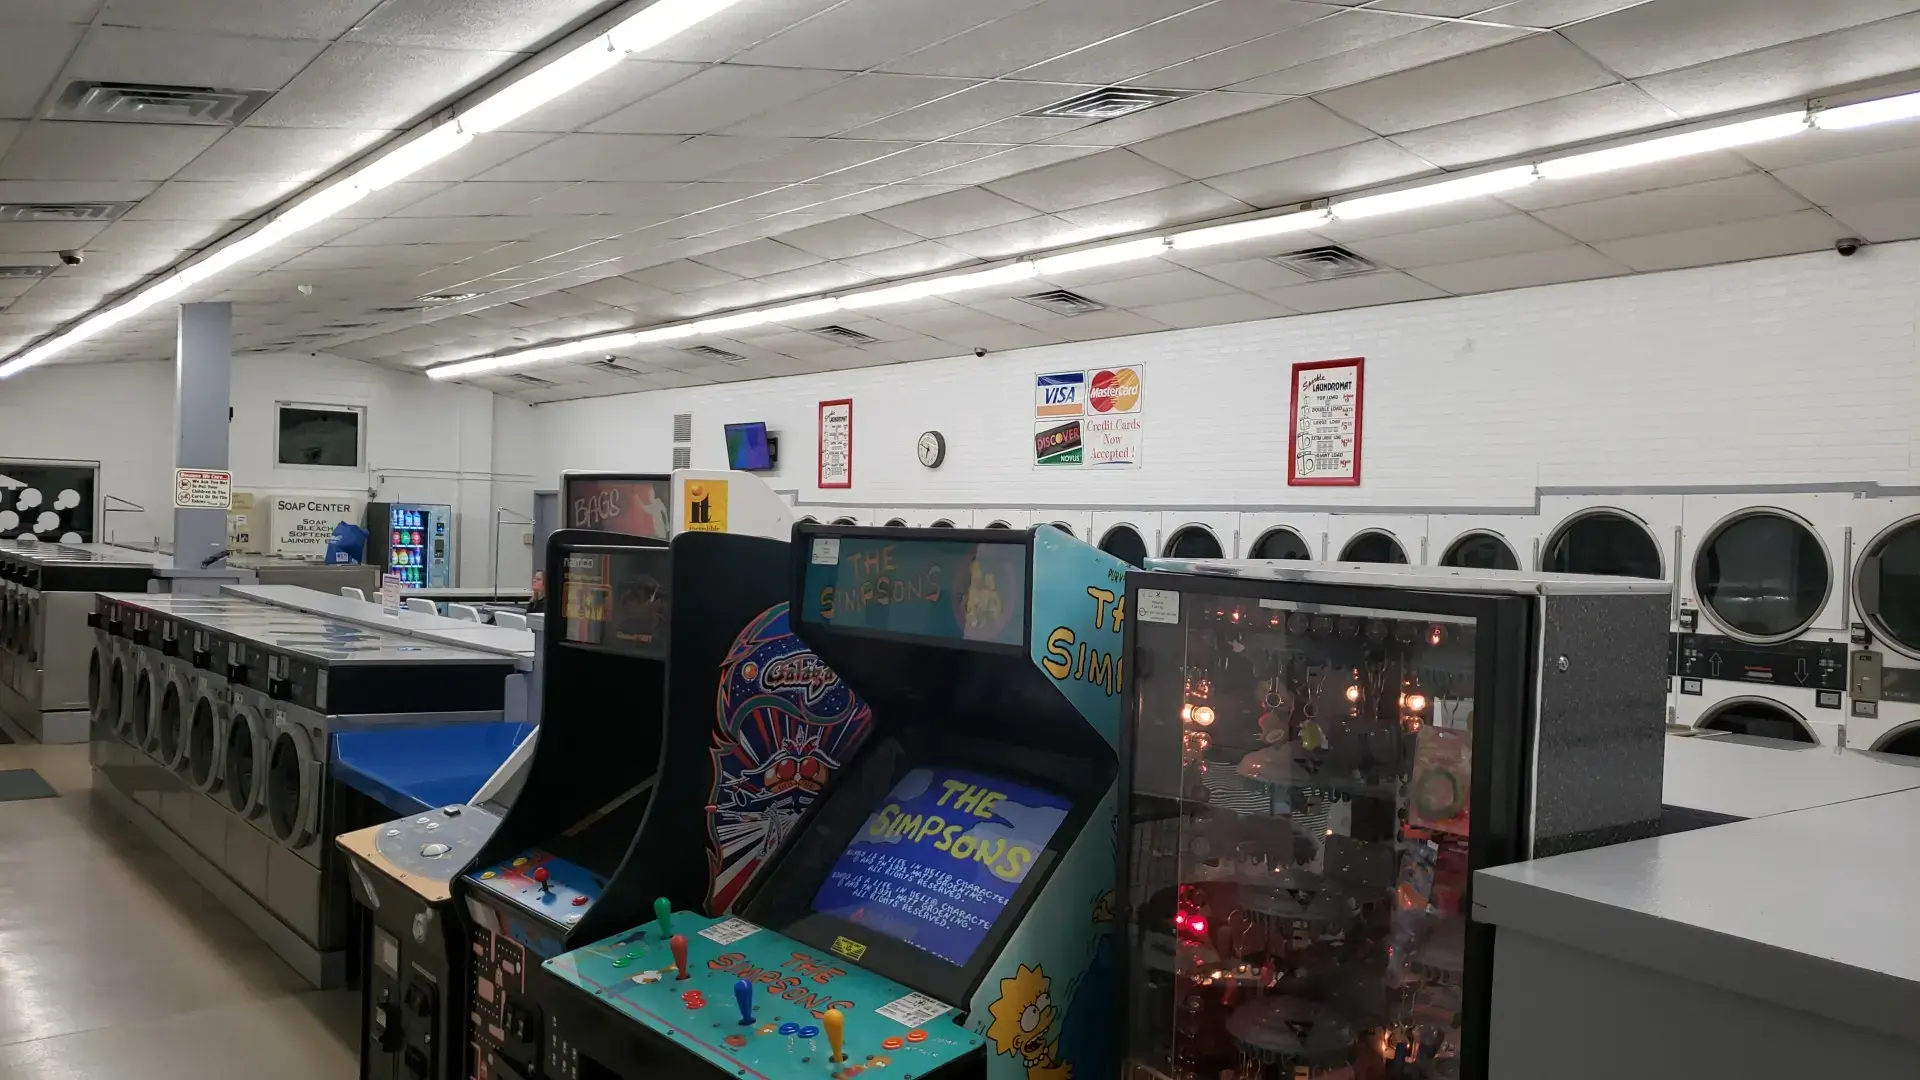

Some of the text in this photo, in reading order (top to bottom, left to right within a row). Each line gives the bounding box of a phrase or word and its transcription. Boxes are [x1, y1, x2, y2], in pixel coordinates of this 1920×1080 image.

[1045, 386, 1075, 404] VISA
[1090, 384, 1138, 399] MasterCard
[1312, 381, 1352, 392] LAUNDROMAT
[1087, 418, 1141, 431] Credit Cards
[1037, 427, 1079, 450] DISCOVER
[1103, 433, 1123, 445] Now
[1060, 454, 1080, 462] NOVUS
[1090, 447, 1129, 460] Accepted
[278, 500, 351, 512] SOAP CENTER
[574, 487, 620, 528] BAGS
[689, 485, 715, 523] it
[289, 530, 332, 538] SOFTENE
[296, 524, 333, 532] BLEACH
[563, 557, 594, 568] namco
[846, 544, 896, 578] THE
[1107, 568, 1125, 582] PURV
[820, 565, 941, 619] SIMPSONS
[764, 653, 838, 701] Galaga
[936, 779, 1008, 819] THE
[868, 804, 1032, 879] SIMPSONS
[889, 862, 908, 874] 1991
[910, 869, 933, 881] MATT
[910, 862, 922, 870] IN
[867, 864, 965, 903] ALL RIGHTS RESERVED.
[874, 886, 892, 898] 1991
[895, 893, 919, 906] MATT
[852, 888, 950, 930] ALL RIGHTS RESERVED.
[941, 903, 993, 930] CHARACTE
[780, 951, 848, 984] THE
[707, 952, 855, 1020] SIMPSONS
